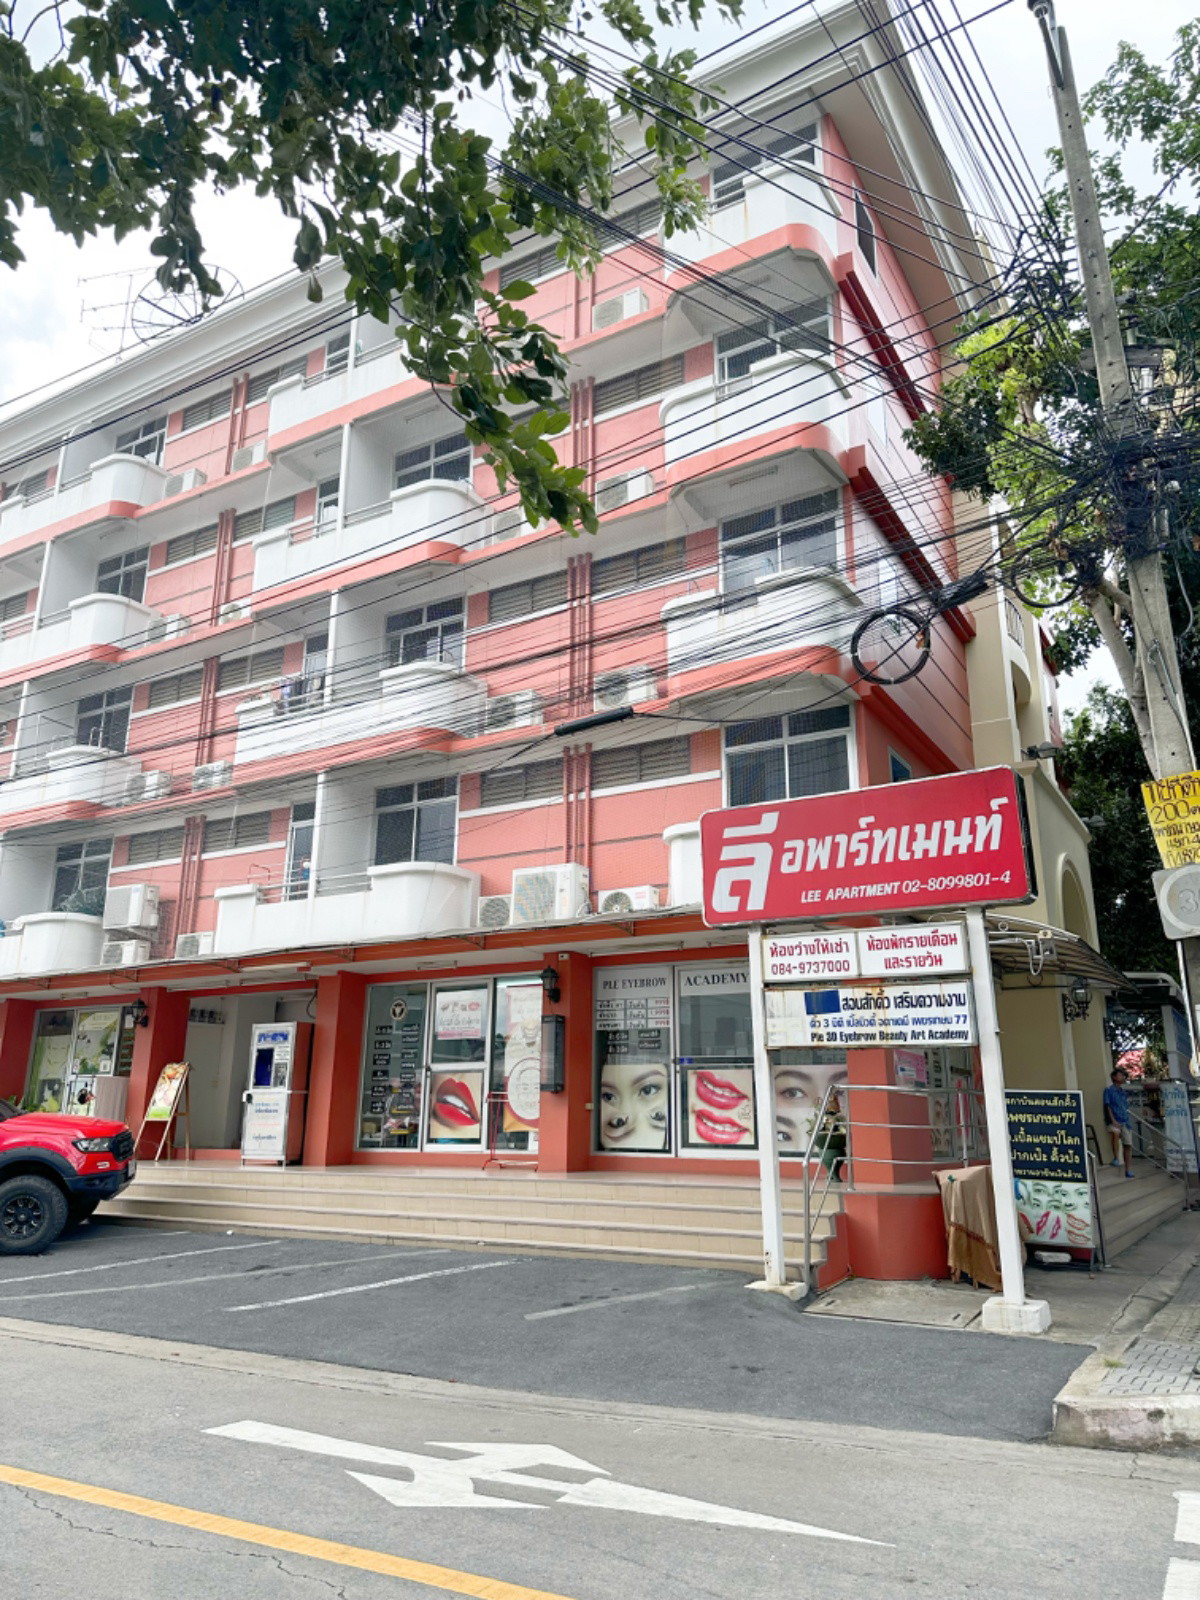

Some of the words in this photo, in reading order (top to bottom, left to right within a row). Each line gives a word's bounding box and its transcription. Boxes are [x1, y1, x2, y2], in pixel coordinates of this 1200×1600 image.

[712, 811, 780, 914] ลี
[780, 796, 1009, 874] อพาร์ทเมนท์
[802, 890, 821, 904] LEE
[825, 882, 900, 902] APARTMENT
[902, 870, 1011, 894] 02-8099801-4
[1179, 889, 1200, 913] 3
[769, 938, 849, 958] ห้องว่างให้เช่า
[866, 929, 958, 951] ห้องพักรายเดือน
[771, 960, 850, 976] 084-9737000
[884, 951, 943, 970] และรายวัน
[603, 980, 619, 990] PLE
[622, 977, 667, 989] EYEBROW
[684, 973, 750, 987] ACADEMY
[842, 988, 891, 1011] สอนสักคิ้ว
[893, 991, 966, 1009] เสริมความงาม
[823, 1018, 829, 1028] 3
[954, 1014, 967, 1024] 77
[839, 1031, 877, 1043] Eyebrow
[879, 1030, 908, 1042] Beauty
[910, 1029, 925, 1041] Art
[928, 1029, 969, 1041] Academy
[1062, 1112, 1077, 1125] 77
